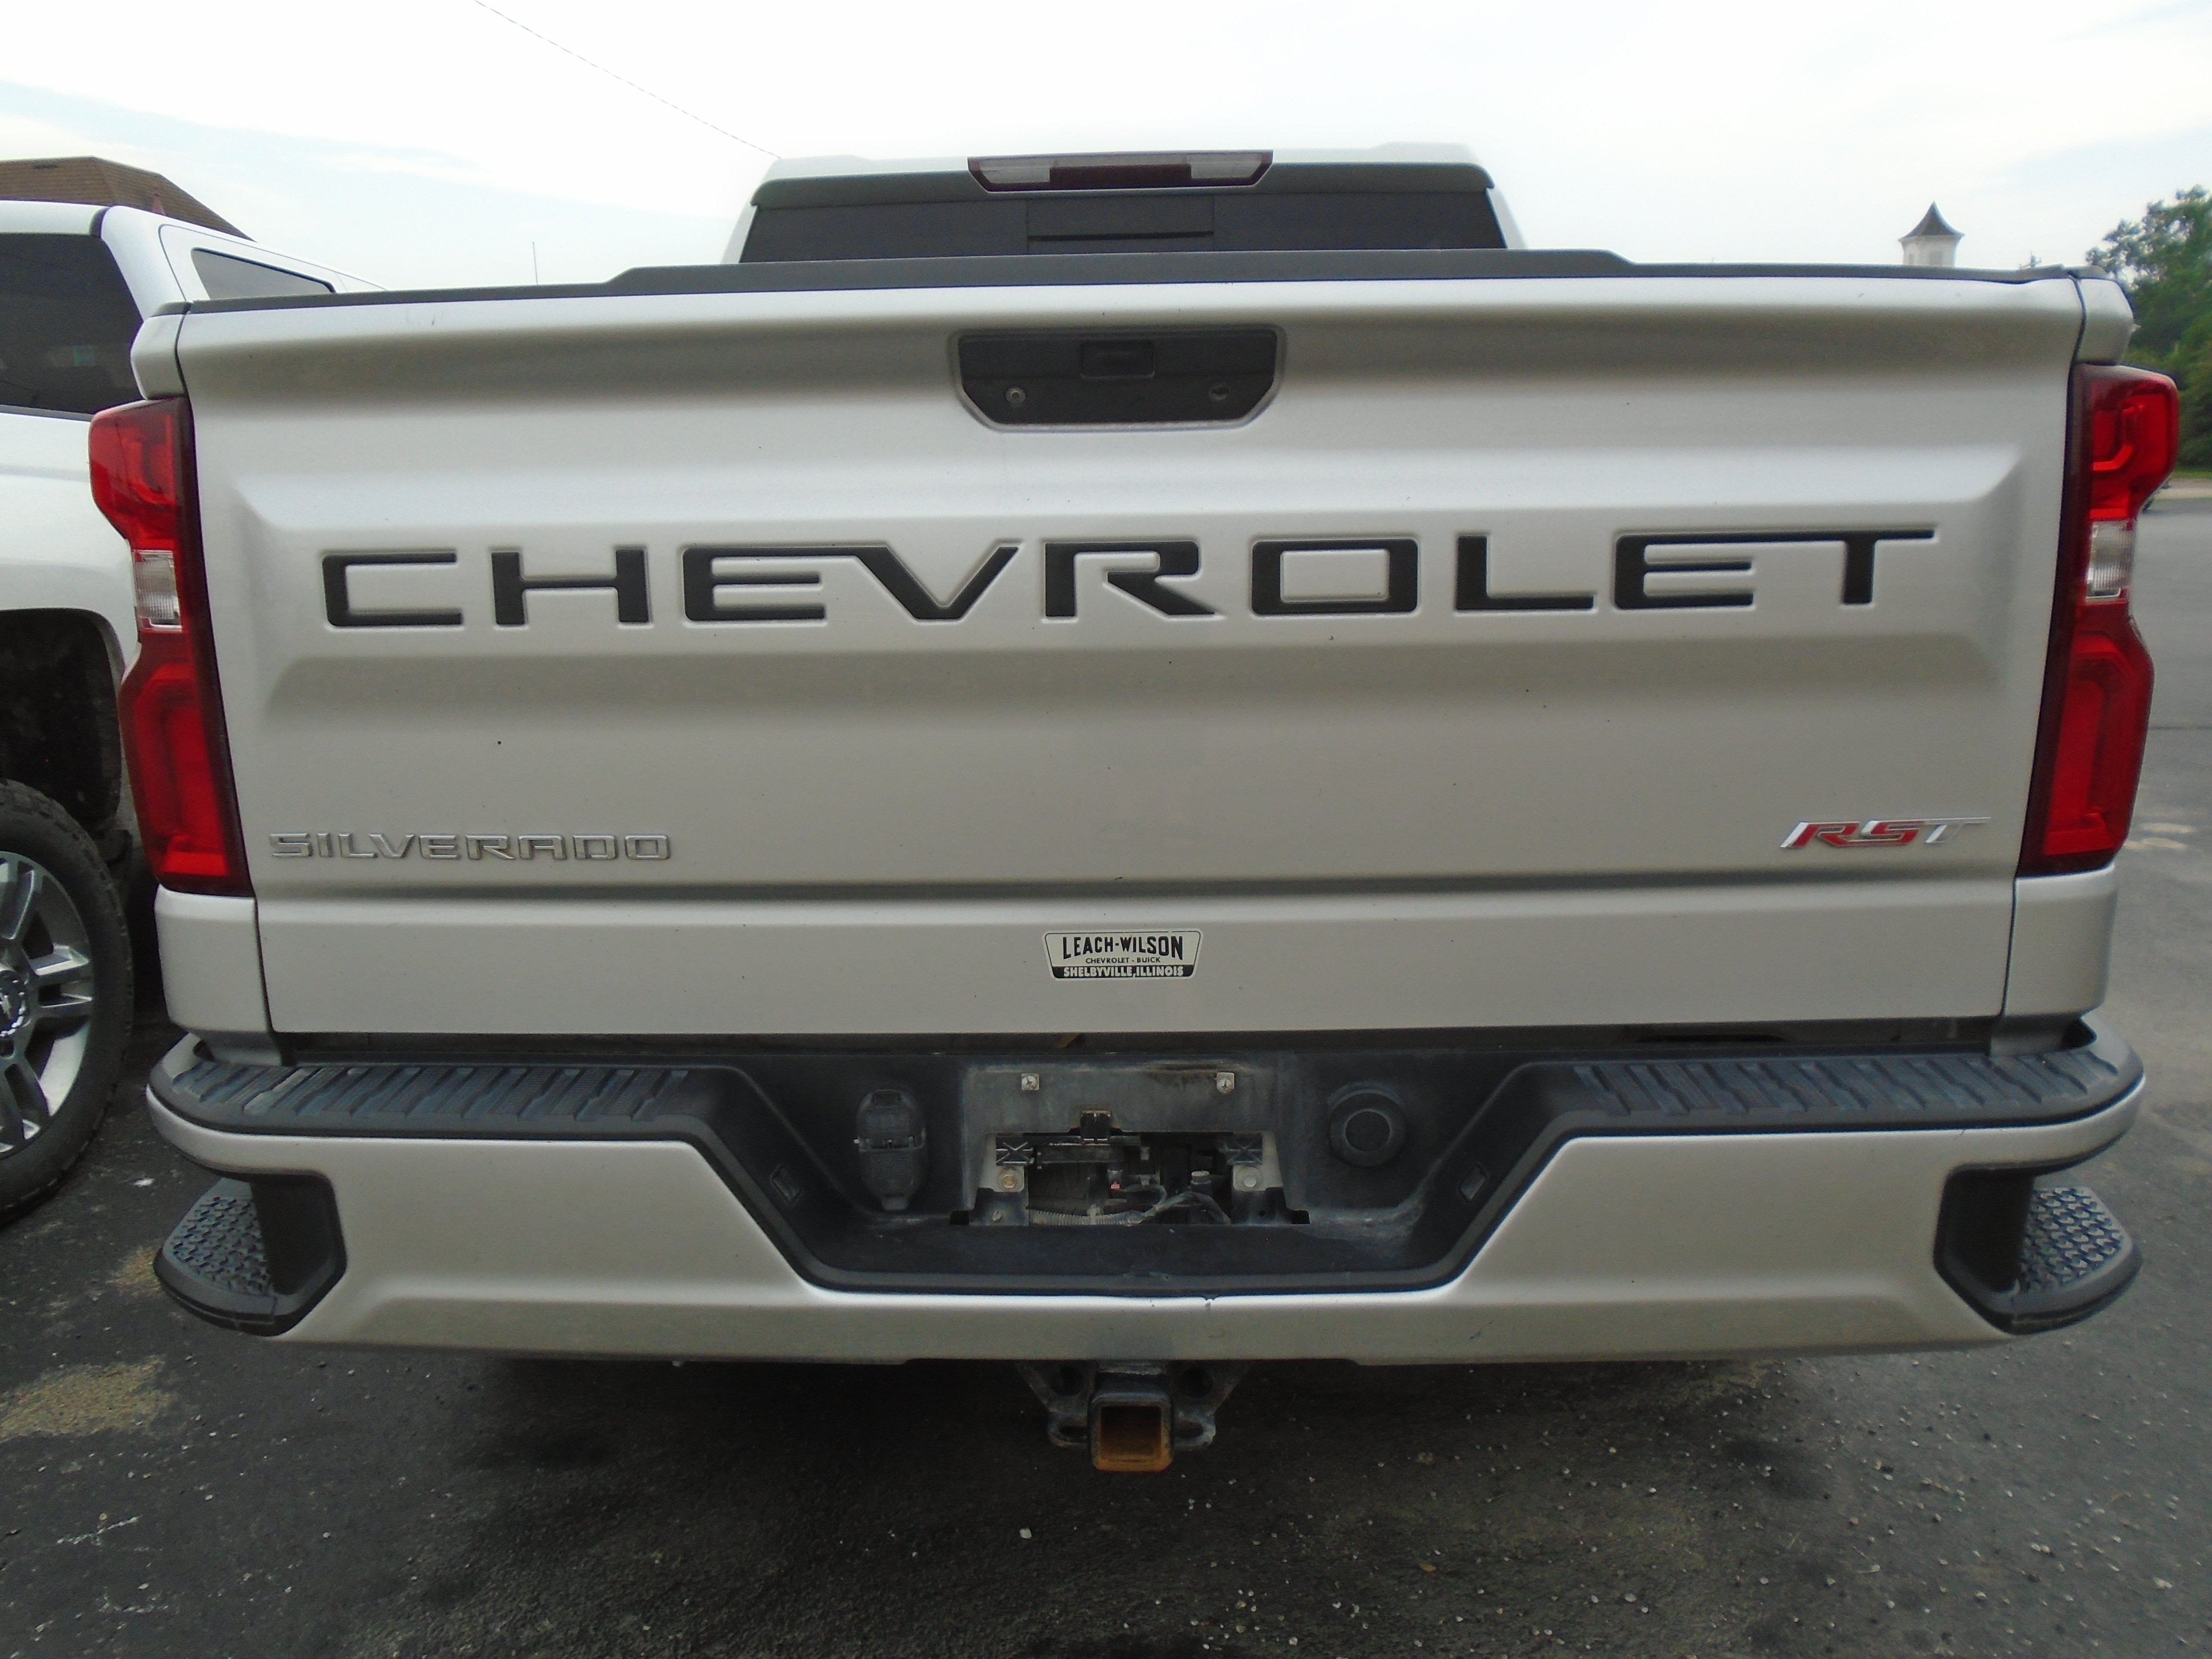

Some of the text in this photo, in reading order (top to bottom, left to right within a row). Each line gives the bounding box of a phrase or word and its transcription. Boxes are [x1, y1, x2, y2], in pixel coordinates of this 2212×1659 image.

[322, 529, 1935, 626] CHEVROLET
[268, 832, 670, 860] SILVERADO
[1780, 817, 1991, 848] RST
[1063, 936, 1183, 960] LEACH-WILSON
